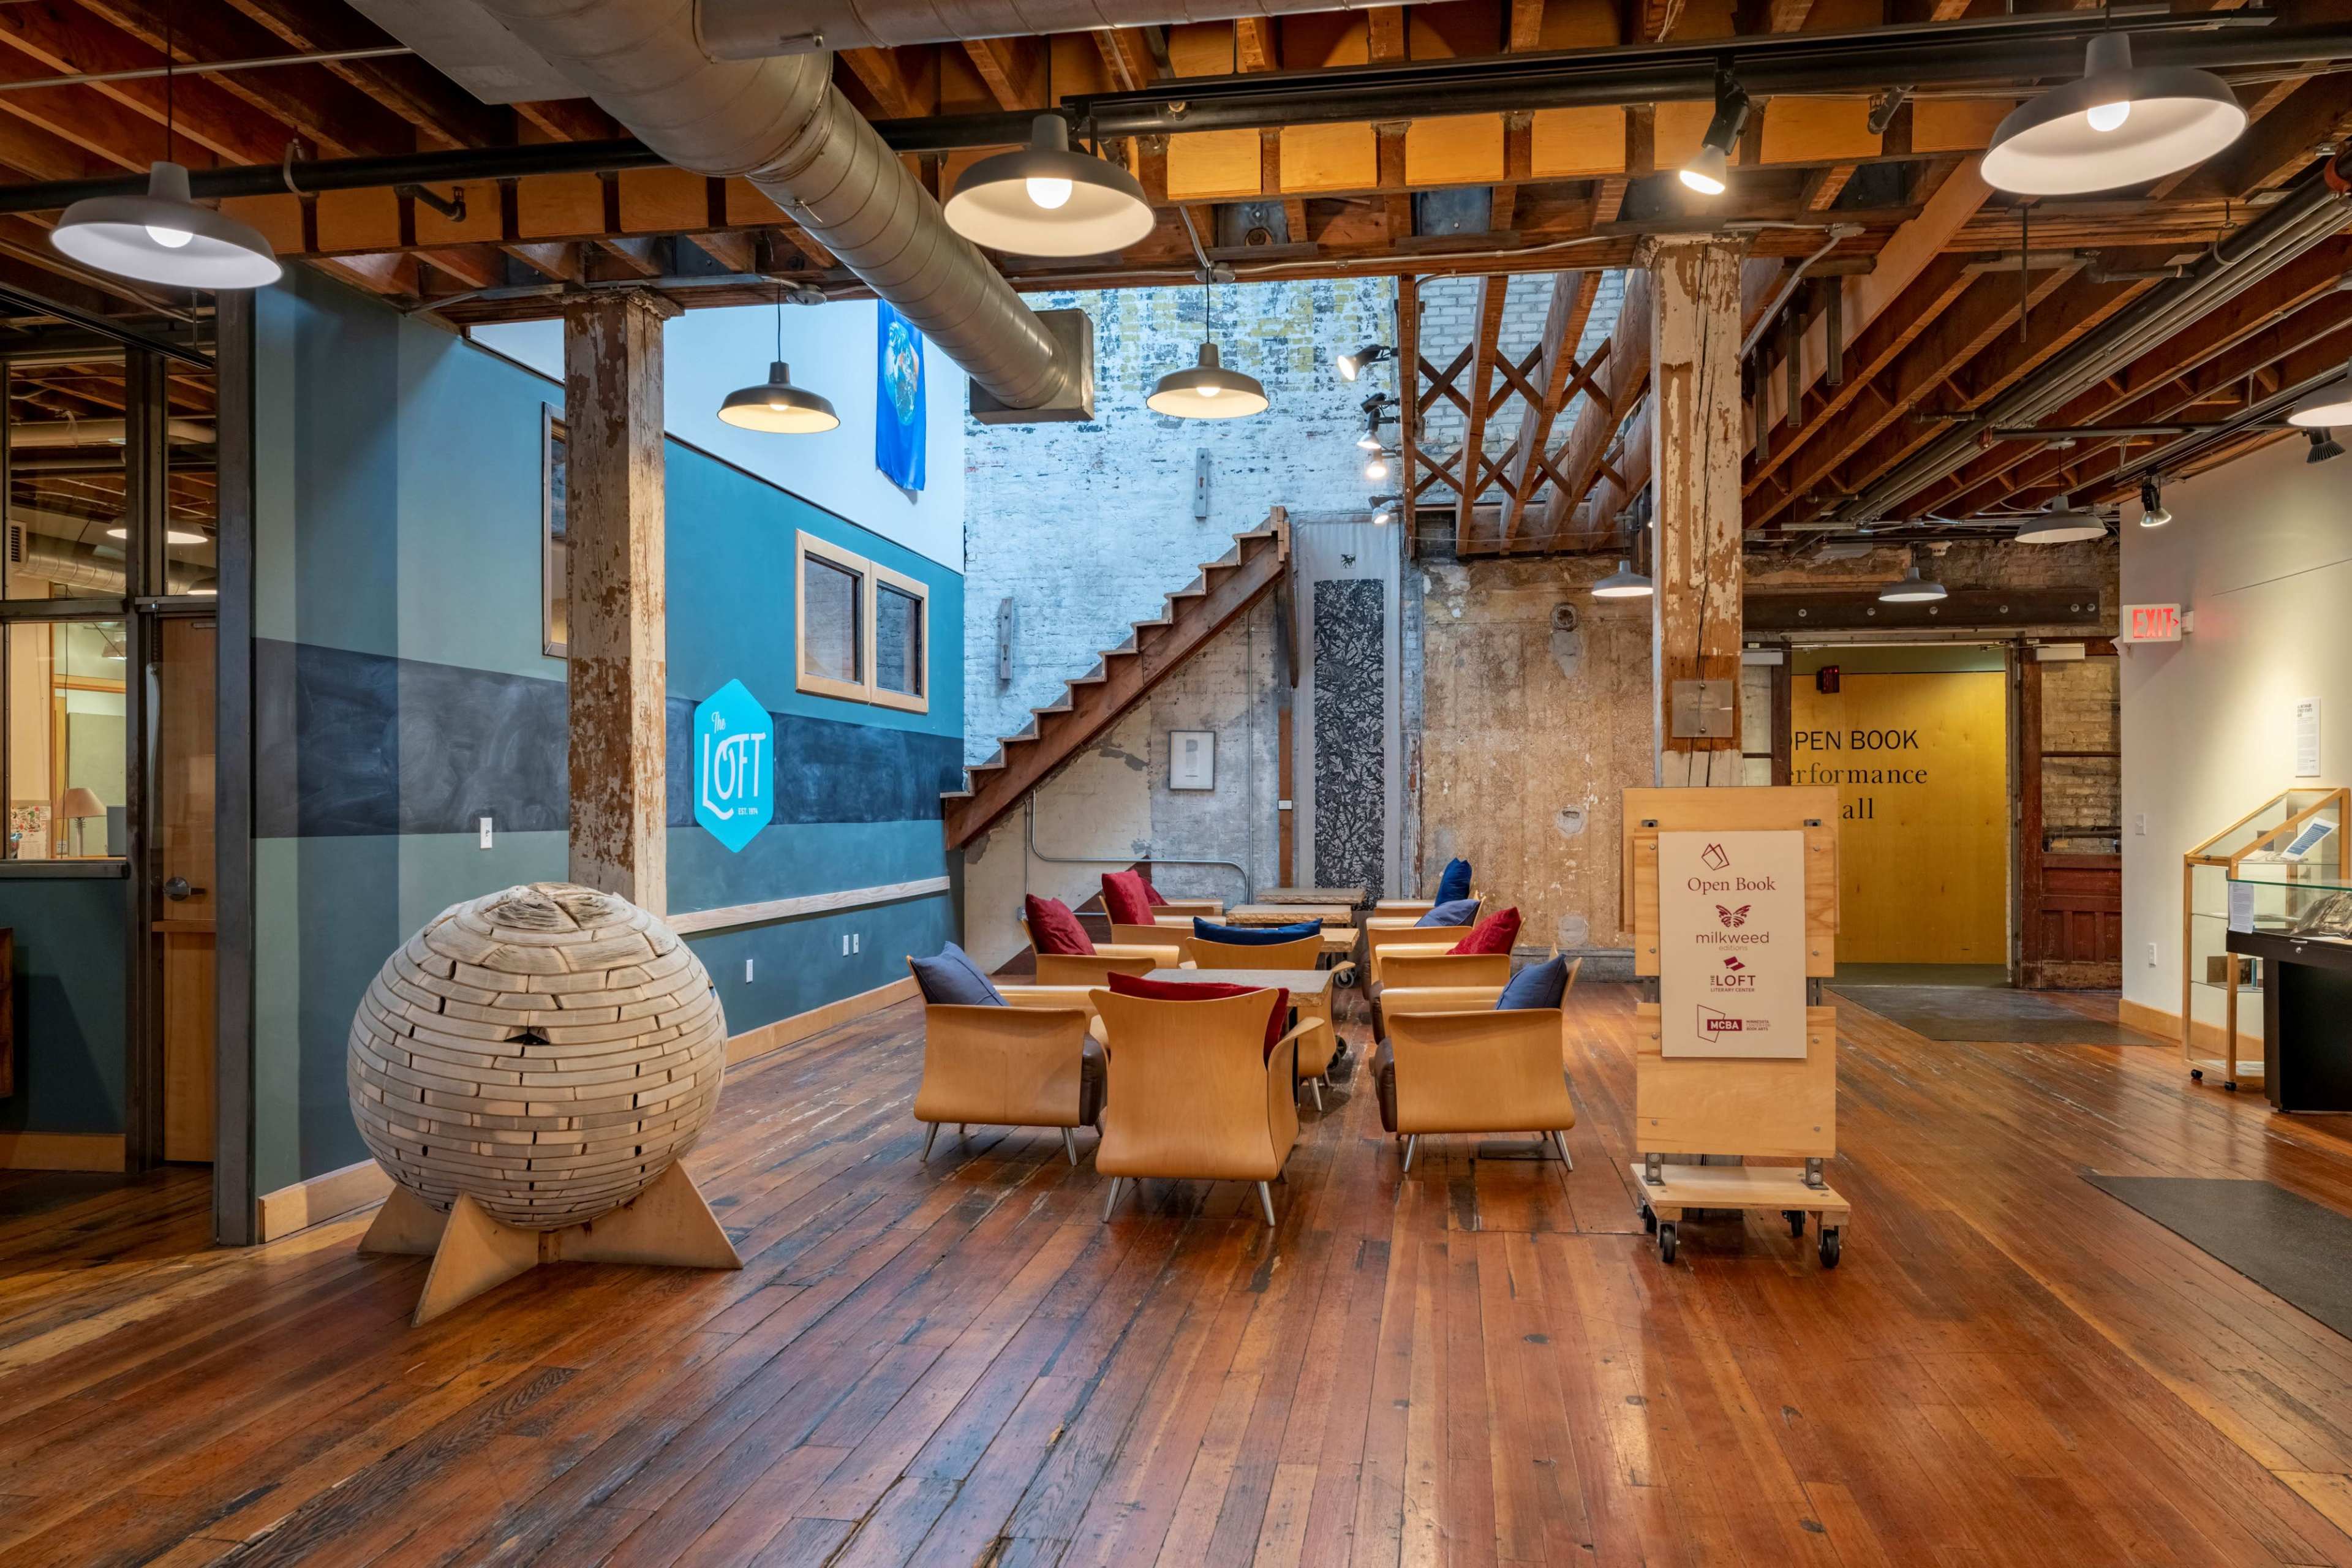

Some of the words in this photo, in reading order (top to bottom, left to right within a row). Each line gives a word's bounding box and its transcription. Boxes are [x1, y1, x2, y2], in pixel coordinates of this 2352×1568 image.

[2133, 608, 2174, 638] EXIT
[712, 712, 726, 733] The
[1790, 731, 1841, 750] PEN
[1852, 729, 1918, 750] BOOK
[703, 733, 766, 820] LOFT
[1838, 797, 1874, 819] all
[1688, 877, 1730, 895] Open
[1735, 876, 1776, 891] Book
[1696, 931, 1770, 944] milkweed
[1716, 975, 1756, 986] LOFT
[1711, 1021, 1740, 1030] MCBA
